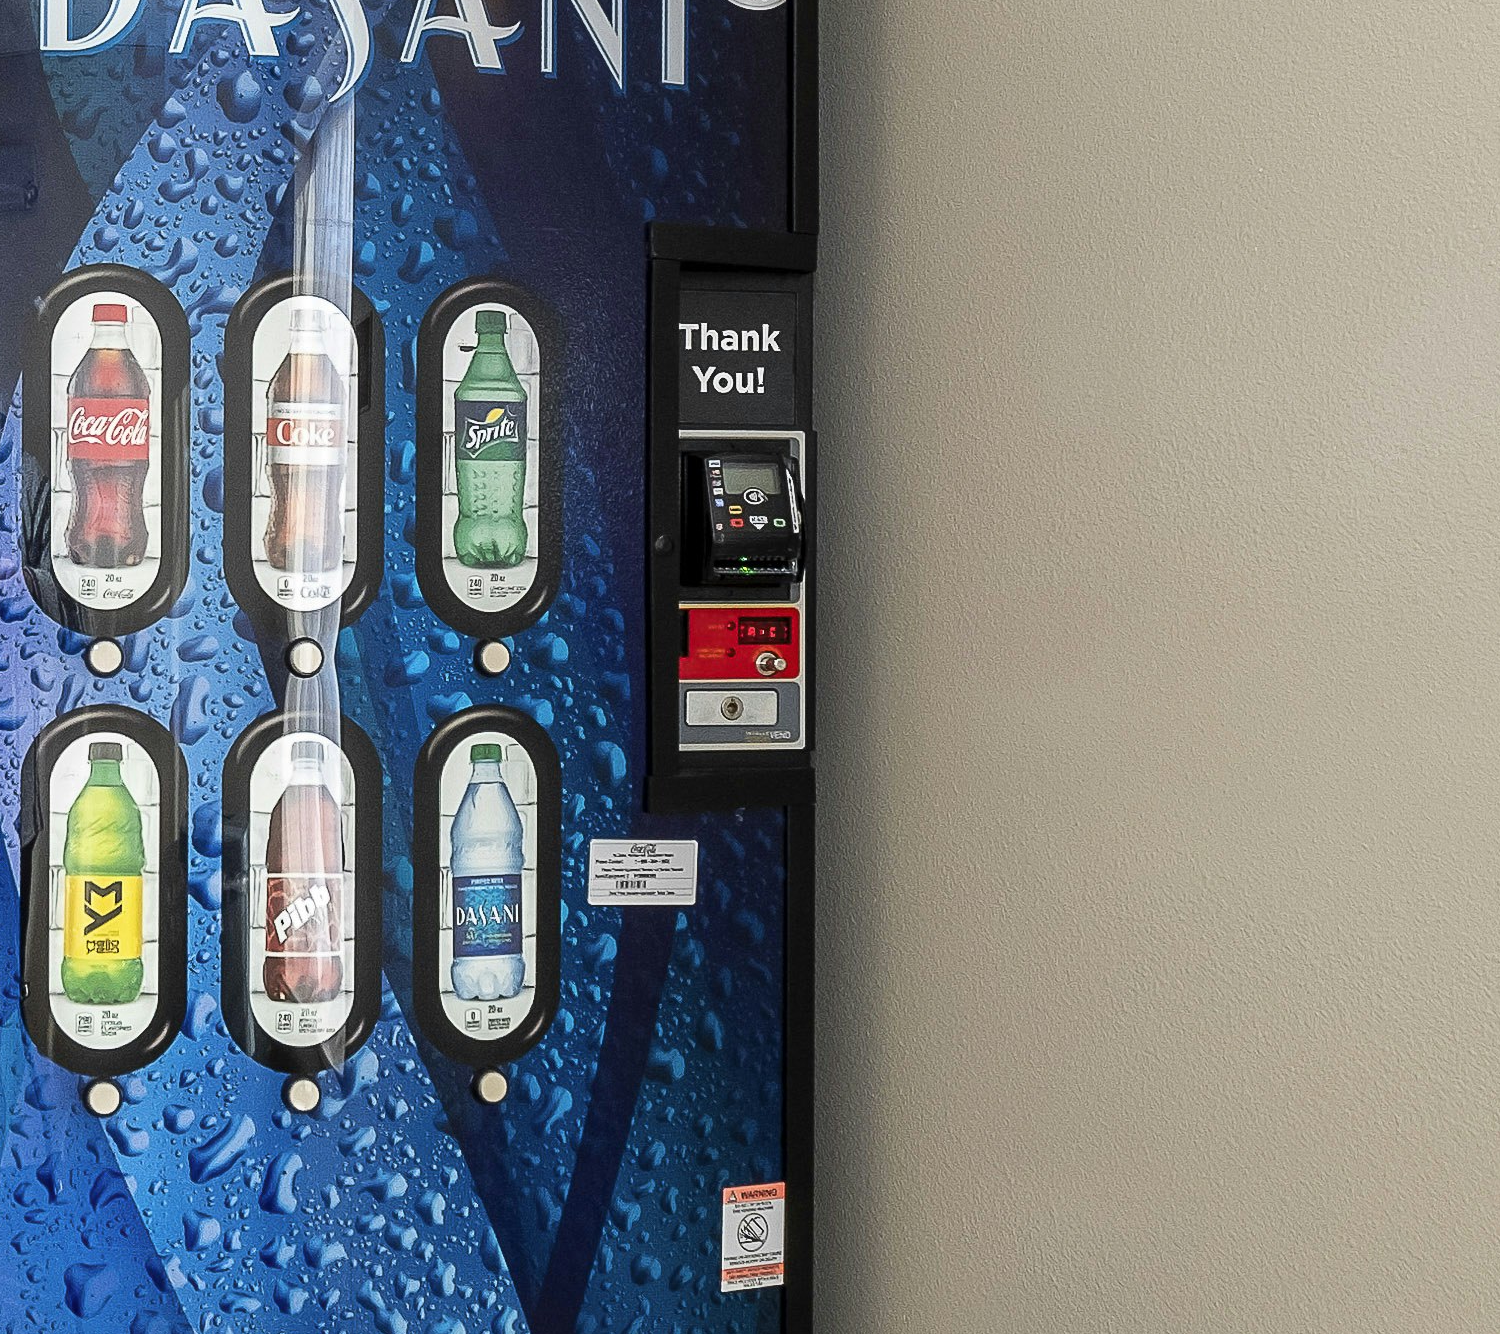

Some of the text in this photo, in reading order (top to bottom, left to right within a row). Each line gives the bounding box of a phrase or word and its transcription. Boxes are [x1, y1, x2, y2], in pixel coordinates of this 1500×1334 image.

[678, 322, 782, 352] Thank
[691, 365, 765, 394] You!
[276, 419, 335, 446] Coke
[465, 416, 515, 450] Sprite
[81, 578, 96, 588] 240
[456, 898, 519, 928] DASANI
[740, 1188, 778, 1201] WARNING
